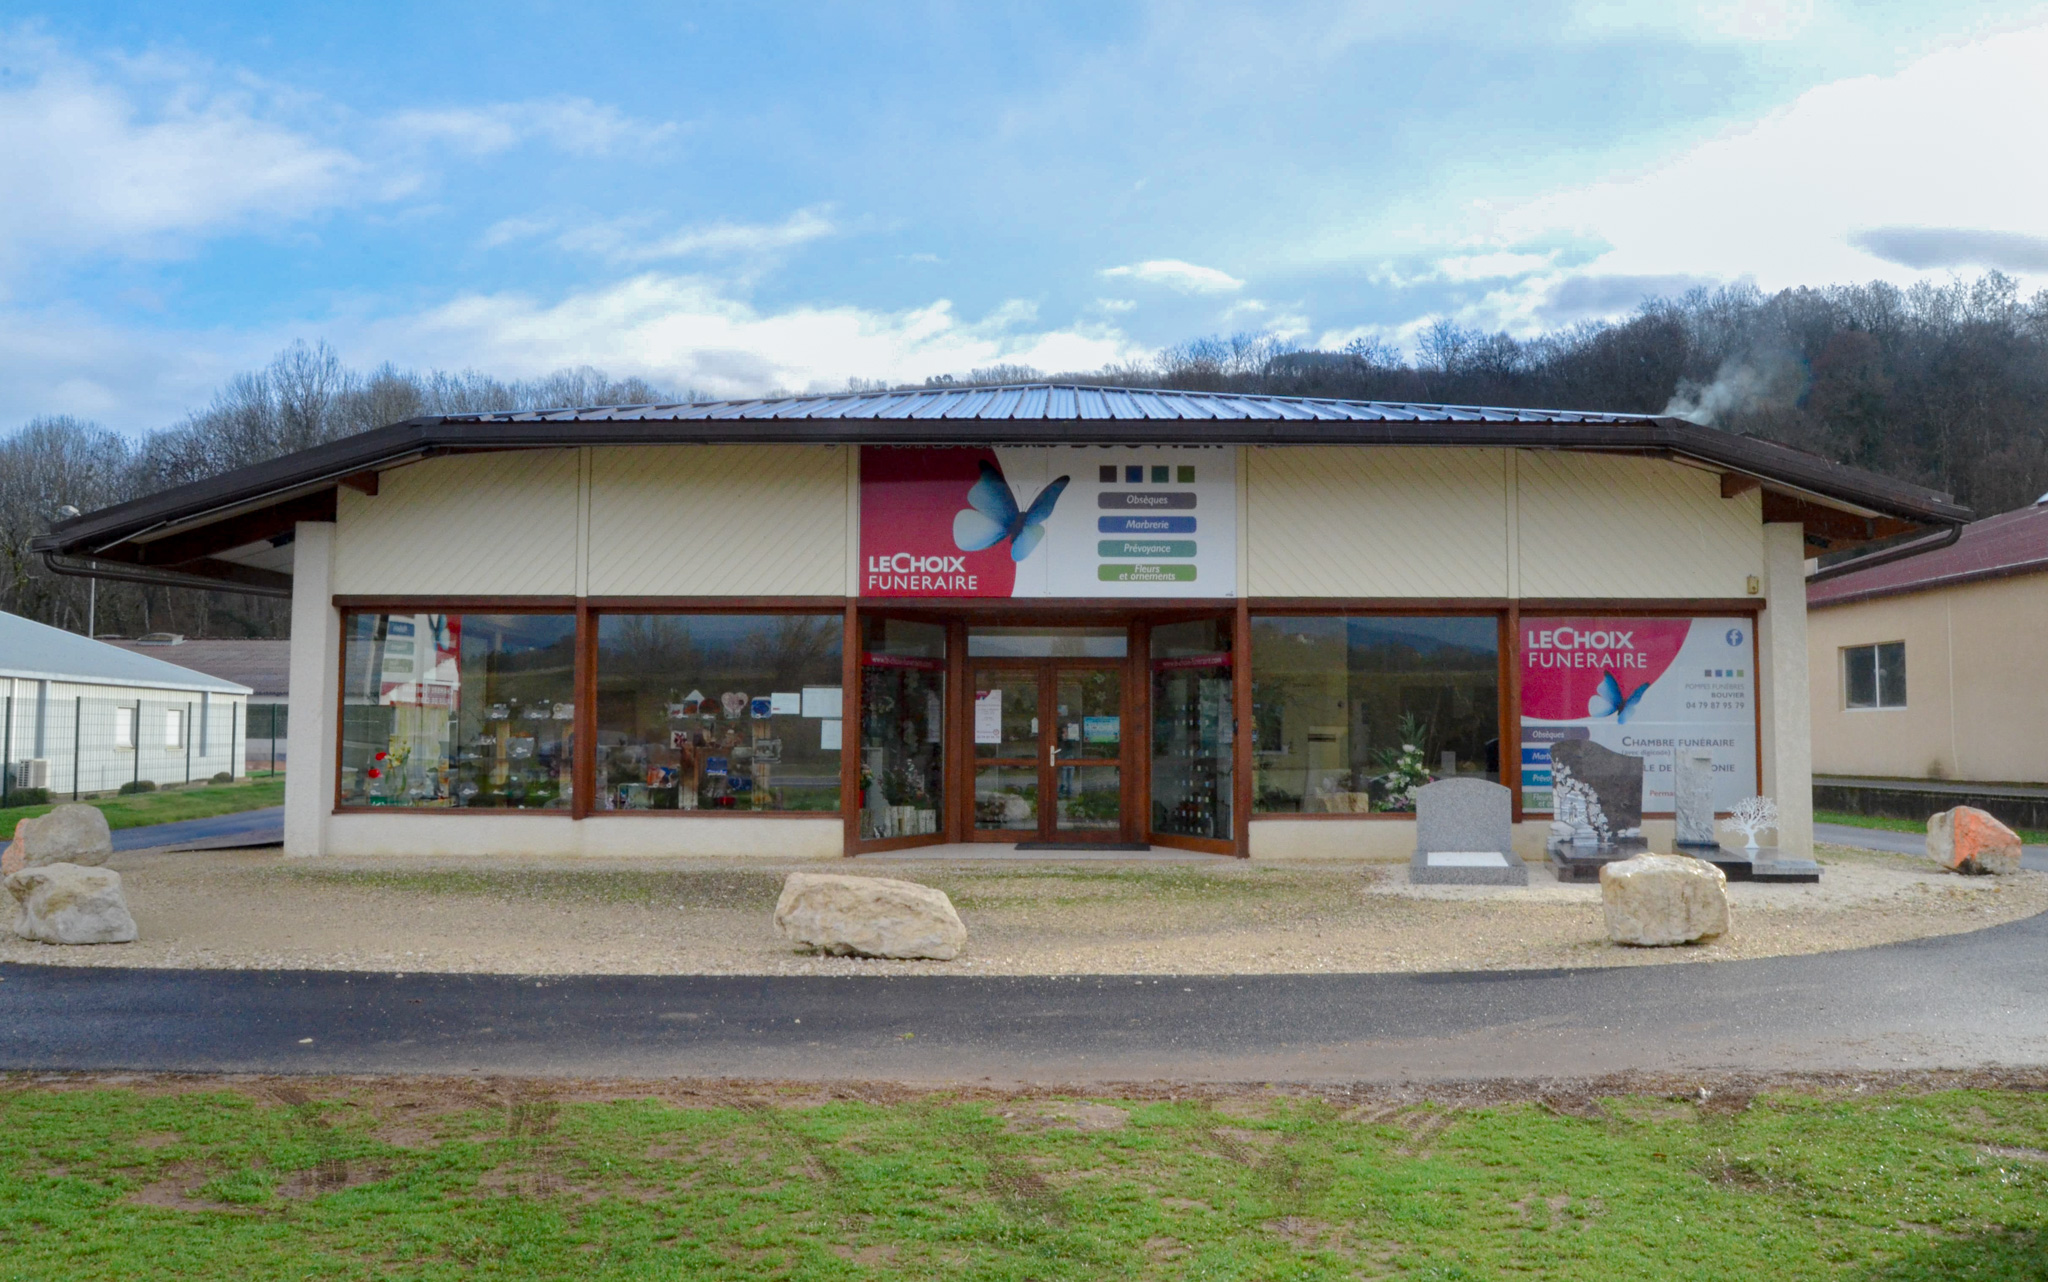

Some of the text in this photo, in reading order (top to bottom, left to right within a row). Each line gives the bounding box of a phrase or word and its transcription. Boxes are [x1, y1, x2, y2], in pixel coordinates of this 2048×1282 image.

[1126, 494, 1168, 506] Obsèques
[1126, 519, 1169, 530] Marbrerie
[1123, 542, 1171, 555] Prévoyance
[1134, 564, 1160, 573] Fleurs
[1119, 572, 1176, 581] et ornements
[868, 575, 978, 590] FUNERAIRE
[1528, 652, 1648, 668] FUNERAIRE
[1685, 701, 1745, 709] 04 79 87 95 79
[1532, 730, 1565, 740] Obsèques
[1659, 764, 1672, 772] DE
